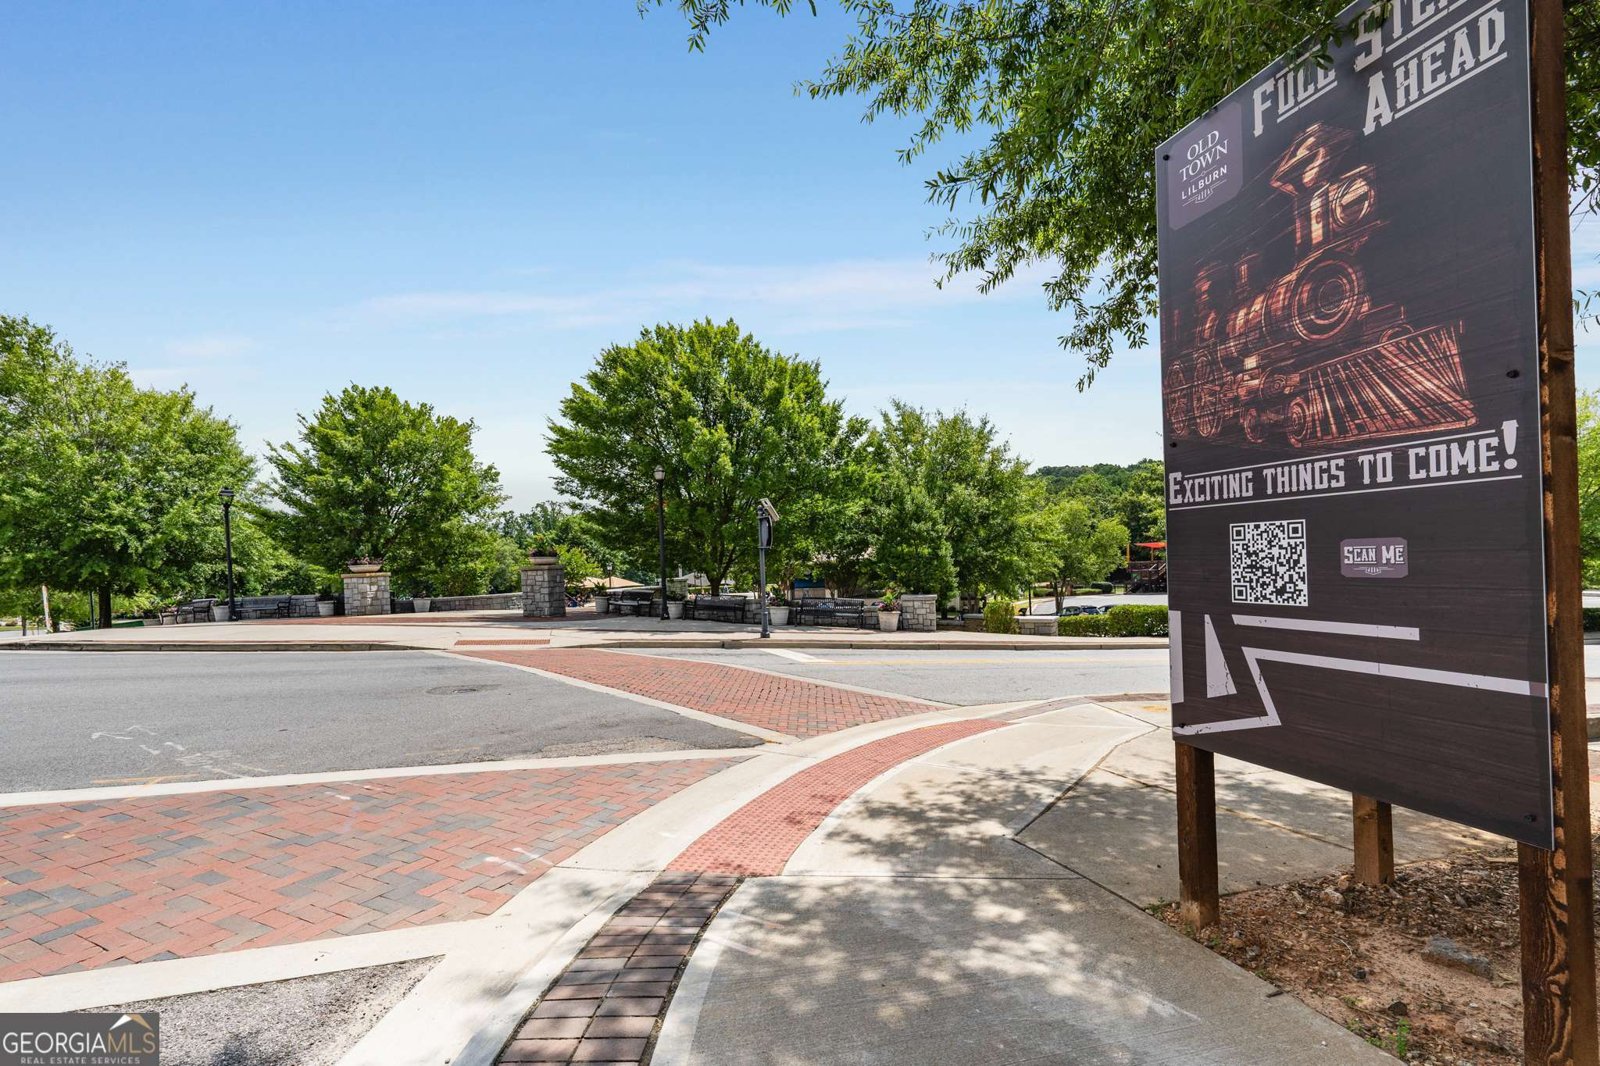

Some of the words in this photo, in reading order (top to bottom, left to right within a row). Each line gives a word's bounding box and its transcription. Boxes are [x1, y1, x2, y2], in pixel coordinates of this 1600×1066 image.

[1253, 56, 1336, 138] FULL
[1354, 0, 1448, 73] STE
[1363, 7, 1506, 136] AHEAD
[1179, 139, 1229, 182] TOWN
[1187, 130, 1219, 160] OLD
[1181, 164, 1227, 200] LILBURN
[1168, 471, 1254, 505] EXCITING
[1262, 458, 1346, 495] THINGS
[1358, 451, 1394, 485] TO
[1408, 419, 1519, 480] COME!
[1343, 545, 1376, 564] SCAN
[1381, 545, 1405, 564] ME
